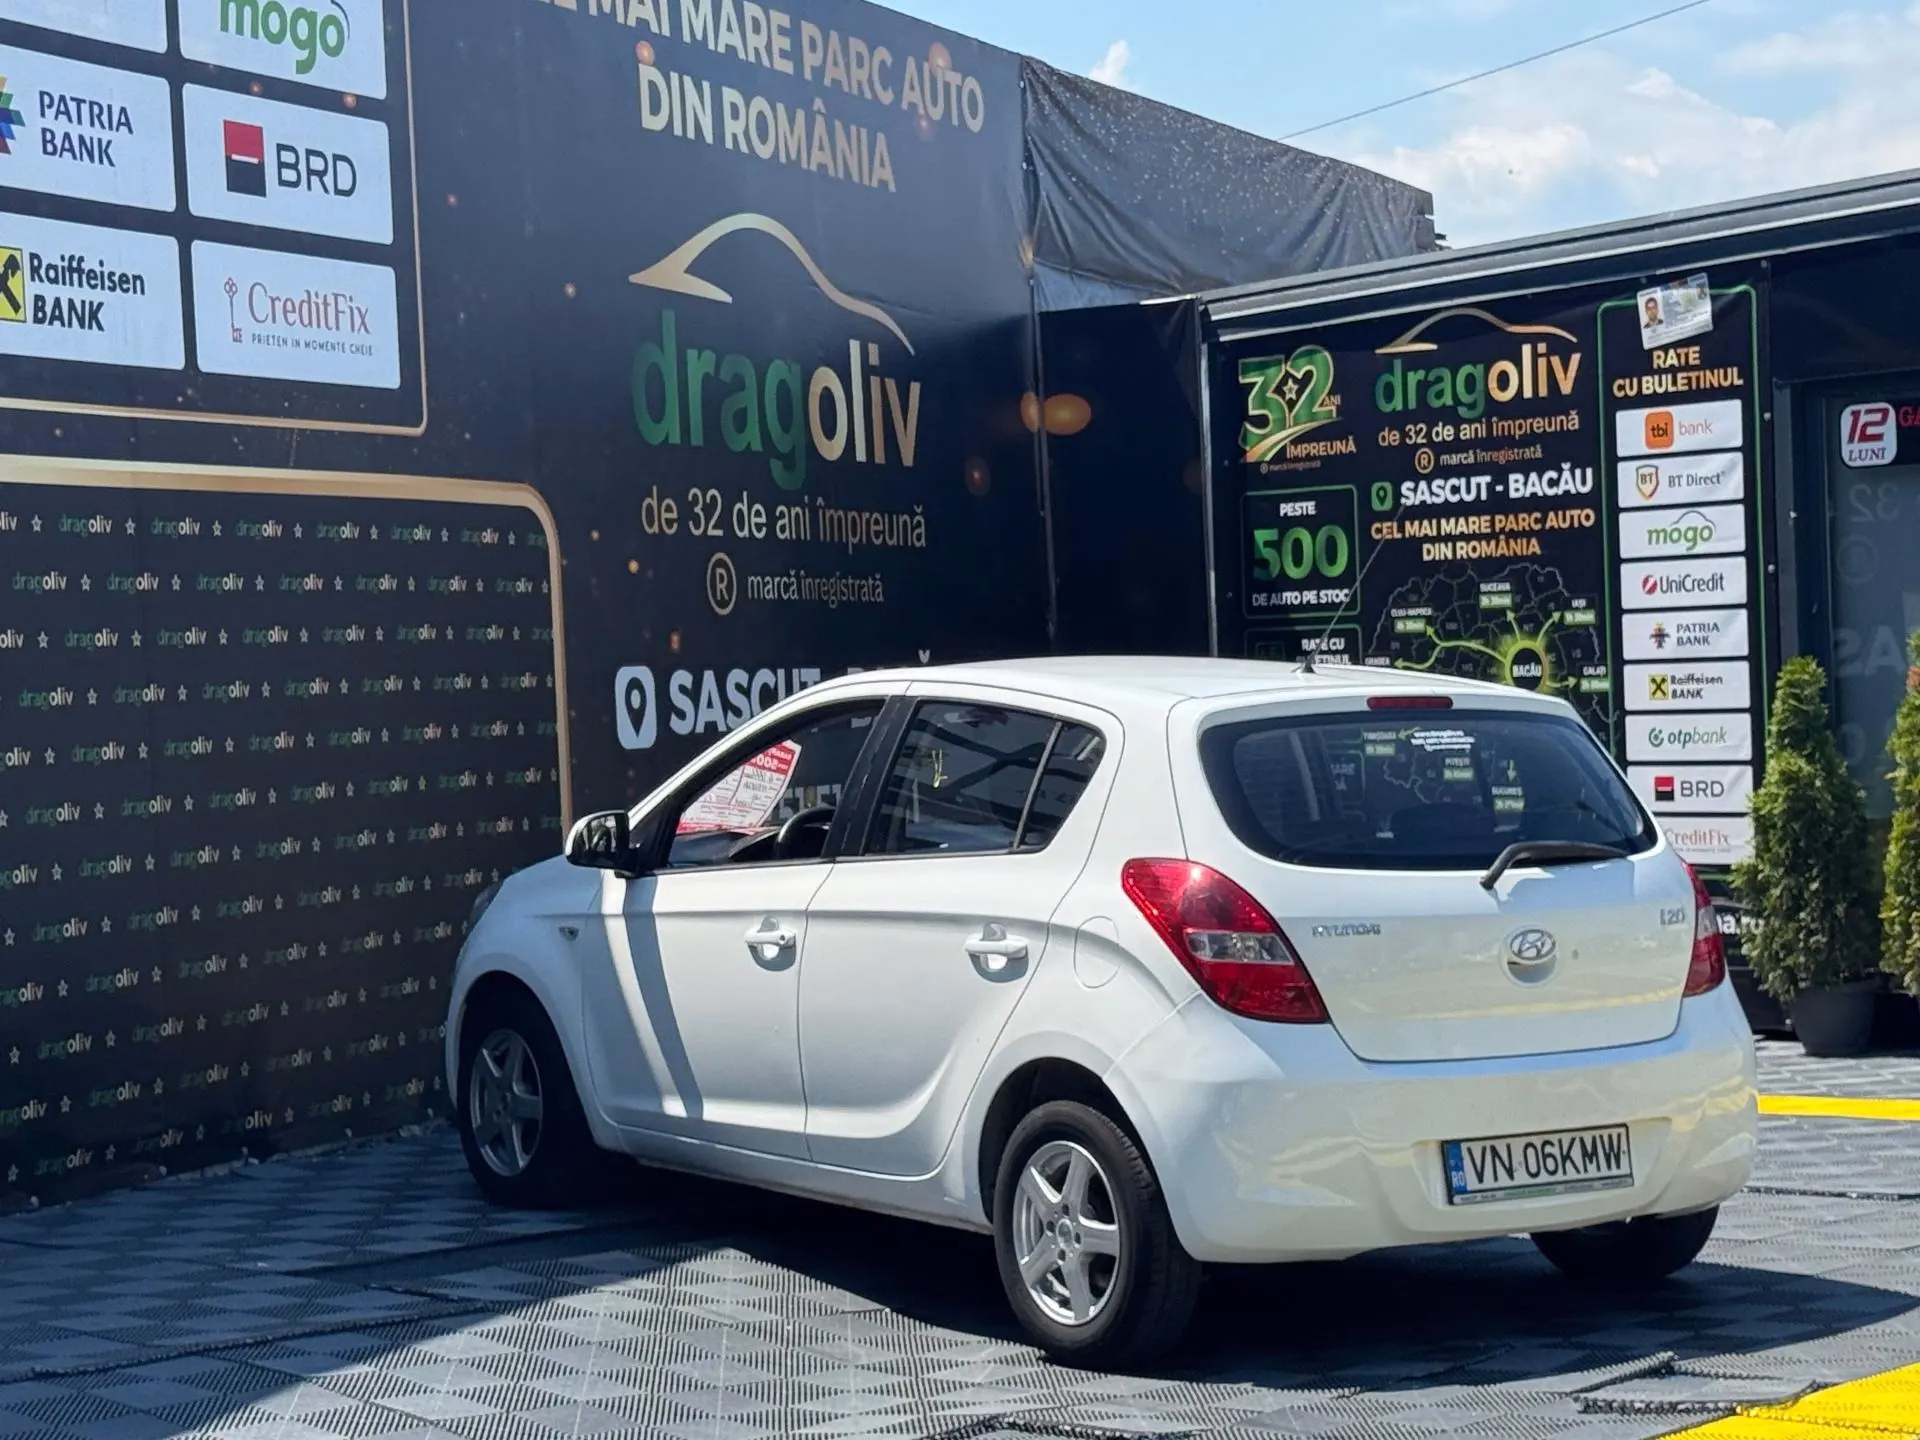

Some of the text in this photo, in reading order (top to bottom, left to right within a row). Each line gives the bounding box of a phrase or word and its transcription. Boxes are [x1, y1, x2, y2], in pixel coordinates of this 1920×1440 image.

[220, 0, 345, 75] mogo
[680, 0, 794, 76] MARE
[801, 19, 895, 106] PARC
[901, 55, 985, 133] AUTO
[39, 91, 134, 135] PATRIA
[638, 64, 897, 193] DIN ROMÂNIA
[41, 127, 116, 167] BANK
[276, 143, 357, 197] BRD
[29, 253, 146, 295] Raiffeisen
[33, 295, 105, 332] BANK
[248, 282, 371, 335] CreditFix
[252, 333, 288, 348] PRIETEN
[291, 339, 301, 348] IN
[1653, 346, 1701, 369] RATE
[1375, 342, 1582, 419] dragoliv
[1613, 367, 1744, 398] CU BULETINUL
[631, 309, 921, 491] dragoliv
[1239, 344, 1334, 450] 32
[1378, 409, 1580, 447] de 32 de ani împreună
[1651, 421, 1669, 439] tbi
[1678, 419, 1713, 437] bank
[1847, 407, 1889, 445] 12
[1848, 447, 1888, 462] LUNI
[1400, 475, 1492, 506] SASCUT
[1508, 462, 1594, 499] BACĂU
[1668, 474, 1684, 488] BT
[641, 485, 926, 554] de 32 de ani împreună
[1280, 501, 1317, 517] PESTE
[58, 515, 112, 539] dragoliv
[151, 516, 200, 539] dragoliv
[235, 519, 283, 540] dragoliv
[1371, 508, 1595, 541] CEL MAI MARE PARC AUTO
[1647, 523, 1714, 551] mogo
[1253, 524, 1349, 580] 500
[1422, 535, 1541, 562] DIN ROMÂNIA
[12, 571, 68, 594] dragoliv
[106, 572, 159, 594] dragoliv
[195, 572, 244, 594] dragoliv
[278, 573, 324, 594] dragoliv
[1252, 588, 1350, 606] DE AUTO PE STOC
[1659, 573, 1725, 595] UniCredit
[64, 628, 119, 651] dragoliv
[157, 626, 207, 649] dragoliv
[241, 625, 289, 648] dragoliv
[1676, 622, 1720, 634] PATRIA
[1676, 635, 1711, 647] BANK
[1329, 637, 1345, 651] CU
[18, 686, 74, 711] dragoliv
[113, 683, 166, 707] dragoliv
[202, 679, 250, 703] dragoliv
[284, 676, 330, 699] dragoliv
[1670, 674, 1723, 686] Raiffeisen
[1671, 688, 1703, 700] BANK
[71, 741, 125, 766] dragoliv
[164, 735, 213, 760] dragoliv
[248, 730, 295, 753] dragoliv
[1667, 725, 1728, 750] otpbank
[1680, 779, 1725, 798] BRD
[1466, 1131, 1622, 1185] VN 06KMW
[1452, 1170, 1466, 1187] RO
